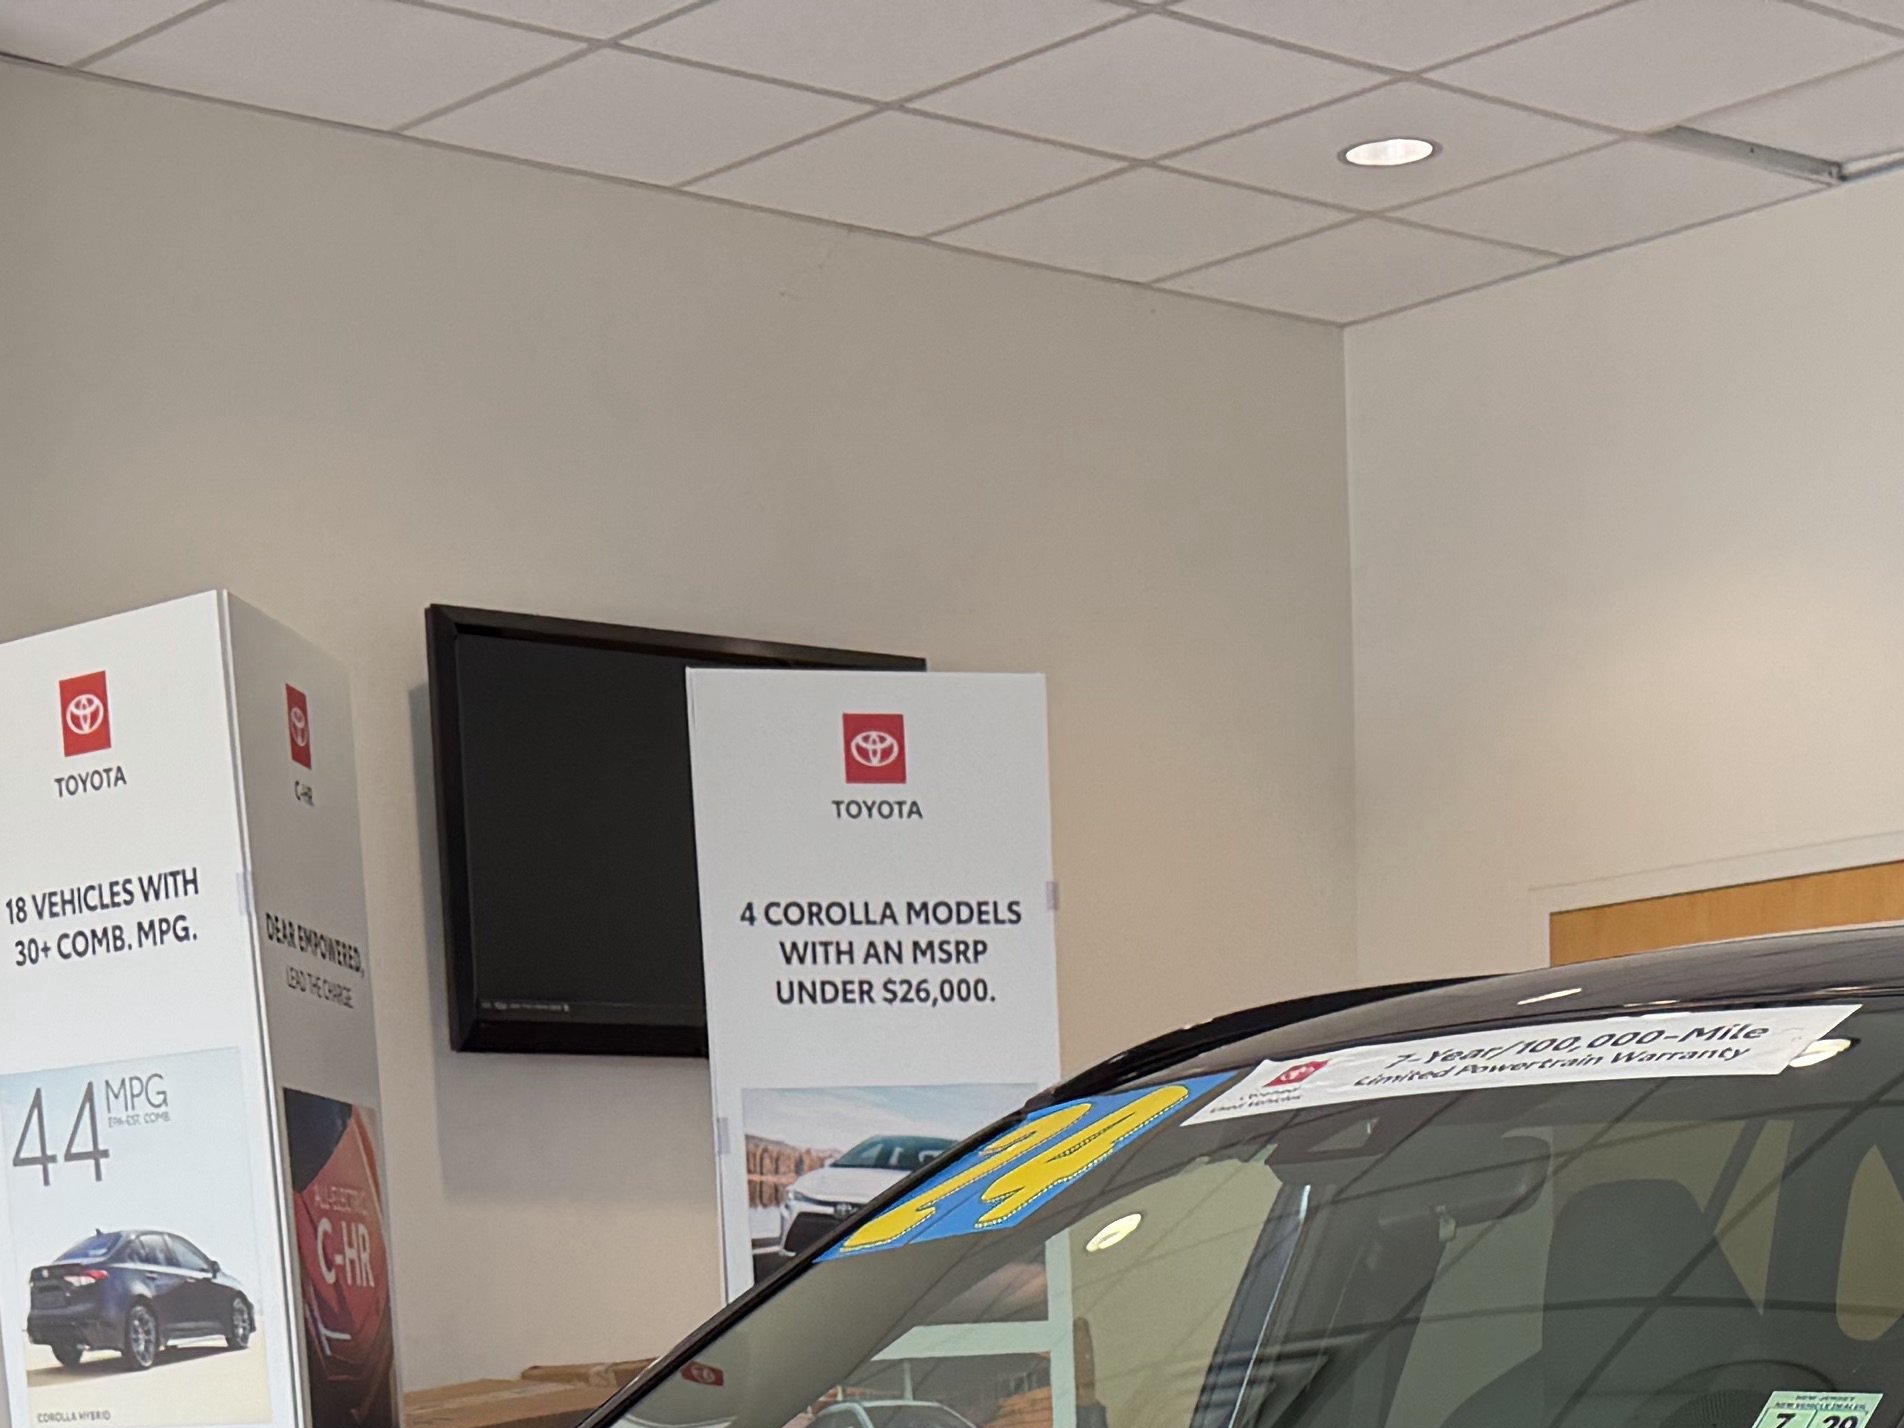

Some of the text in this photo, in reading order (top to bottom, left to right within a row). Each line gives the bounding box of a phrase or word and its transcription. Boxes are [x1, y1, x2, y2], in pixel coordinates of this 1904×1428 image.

[54, 766, 127, 797] TOYOTA
[832, 800, 923, 819] TOYOTA
[6, 867, 199, 924] 18 VEHICLES WITH
[740, 900, 1022, 926] 4 COROLLA MODELS
[15, 915, 197, 966] 30+ COMB. MPG.
[779, 940, 988, 965] WITH AN MSRP
[776, 978, 996, 1007] UNDER $26,000.
[1354, 1046, 1752, 1087] Limited Powertrain Warranty
[1386, 1024, 1770, 1069] 7-Year/100,000-Mile
[13, 1073, 168, 1186] 44 MPG
[317, 1217, 375, 1288] C-HR
